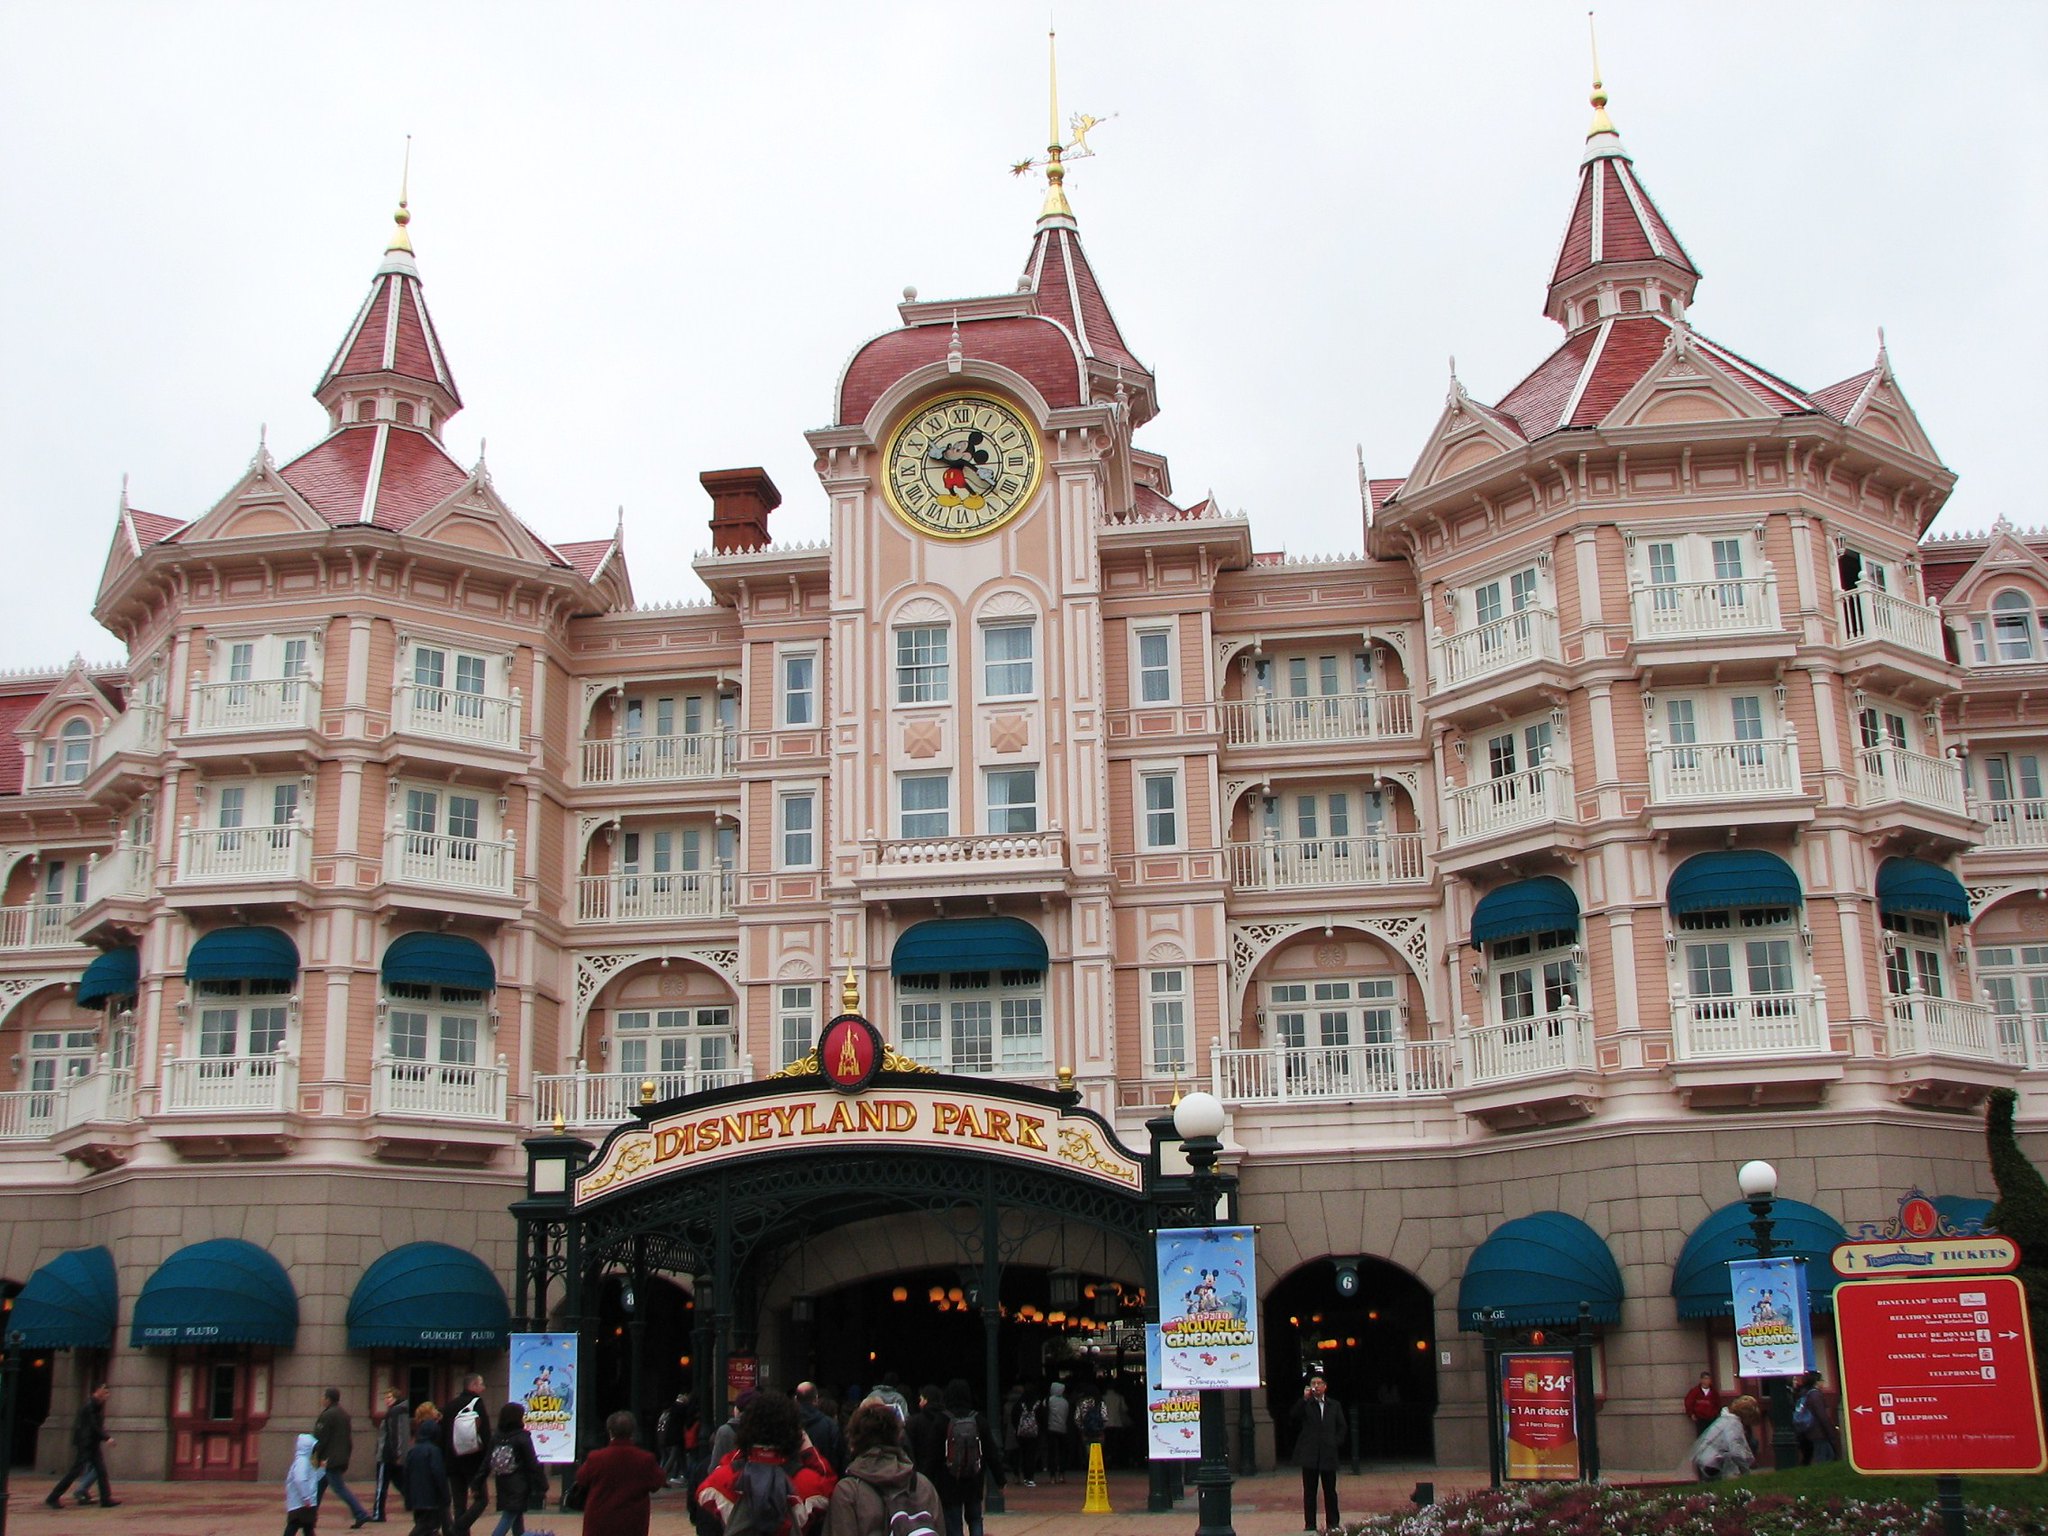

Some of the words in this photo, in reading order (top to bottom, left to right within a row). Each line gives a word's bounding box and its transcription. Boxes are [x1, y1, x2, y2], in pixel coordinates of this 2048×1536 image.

[953, 408, 969, 423] XII
[983, 414, 993, 427] I
[926, 416, 943, 434] XI
[1000, 430, 1016, 443] II
[907, 438, 924, 451] X
[1008, 456, 1024, 467] III
[901, 464, 916, 476] IX
[1001, 479, 1018, 494] IIII
[905, 486, 924, 505] VIII
[926, 504, 943, 521] VII
[985, 501, 998, 515] V
[956, 511, 969, 524] VI
[653, 1099, 918, 1164] DISNEYLAND
[931, 1101, 1049, 1152] PARK
[1940, 1248, 2007, 1261] TICKETS
[1342, 1276, 1353, 1290] 6
[970, 1289, 979, 1303] 7
[1472, 1309, 1505, 1321] CHGE
[144, 1327, 178, 1337] GUICHET
[185, 1326, 219, 1336] PLUTO
[1177, 1319, 1246, 1334] NOUVELLE
[1747, 1325, 1793, 1336] NOUVELLE
[420, 1330, 464, 1340] GUICHET
[471, 1330, 495, 1340] PLUTO
[1888, 1352, 1927, 1360] CONSIGNE
[528, 1395, 562, 1411] NEW
[1517, 1406, 1522, 1415] 1
[1524, 1406, 1536, 1415] An
